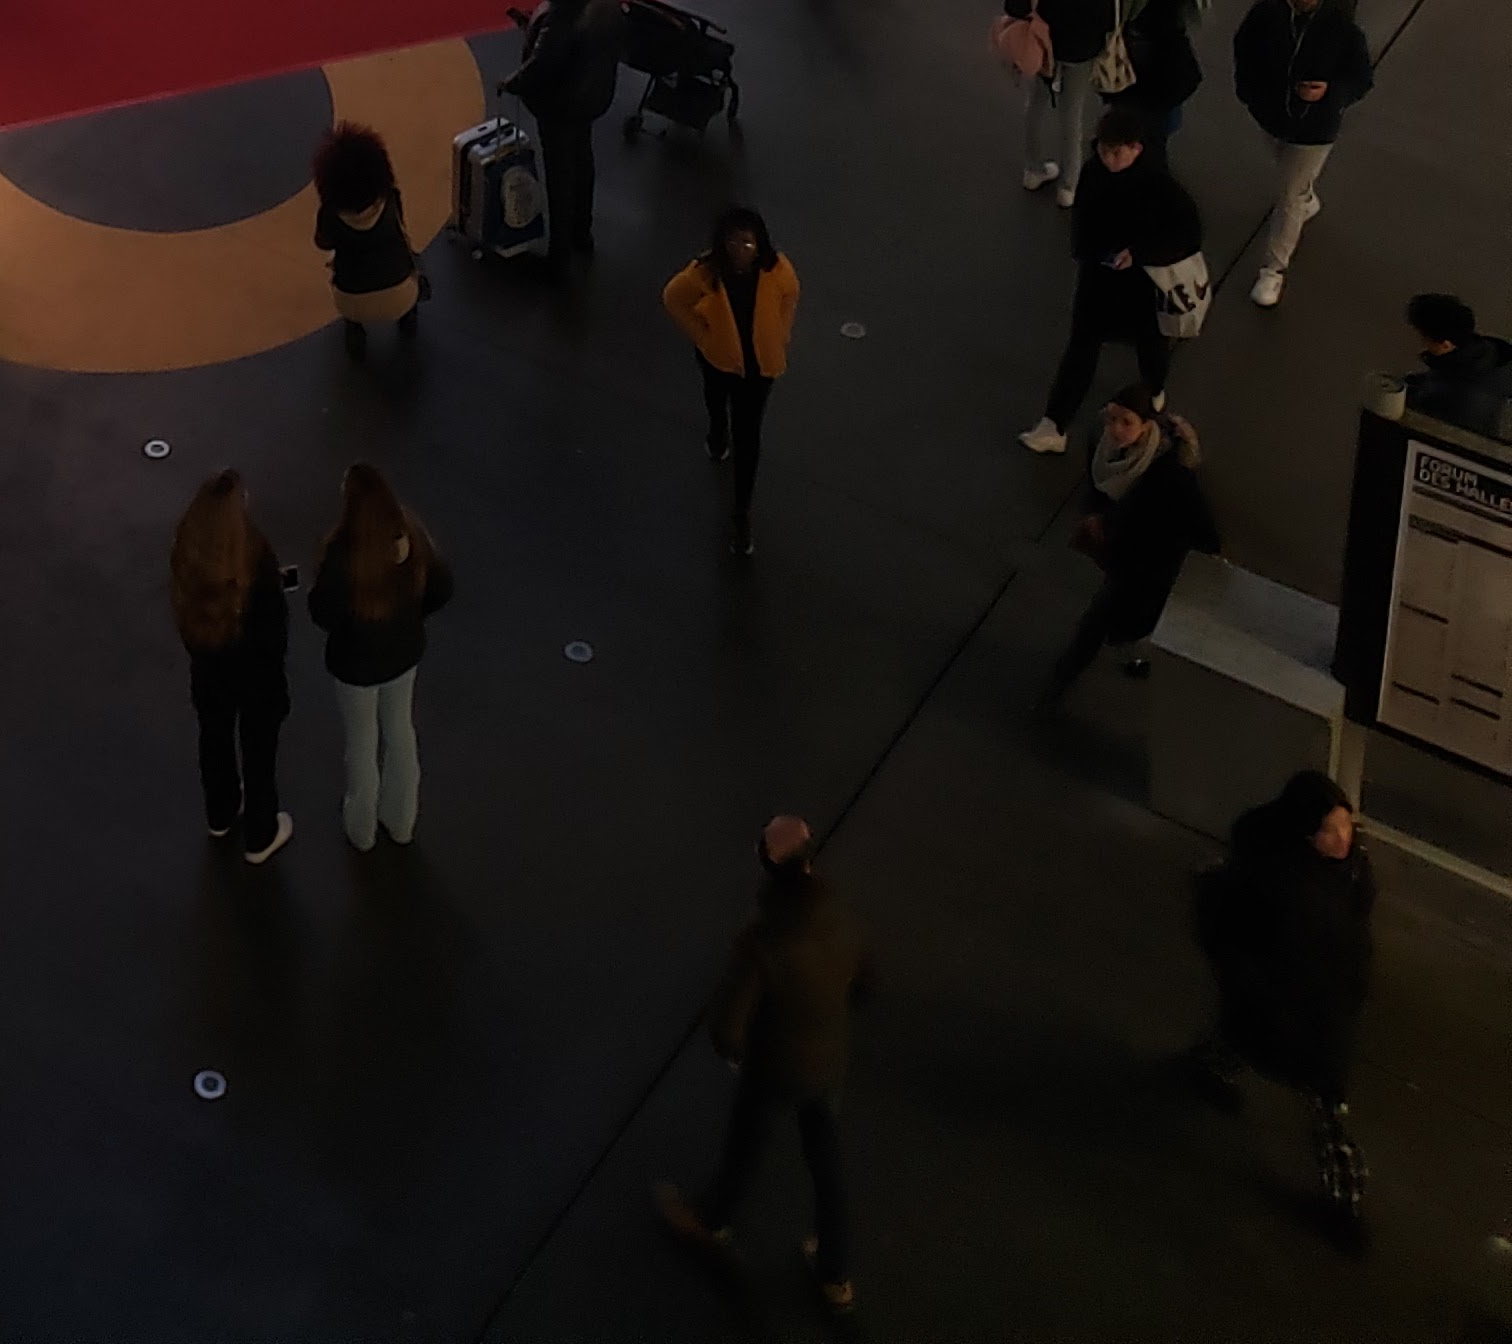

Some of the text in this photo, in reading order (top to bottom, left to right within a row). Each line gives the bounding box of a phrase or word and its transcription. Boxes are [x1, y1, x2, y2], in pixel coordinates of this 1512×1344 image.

[1419, 468, 1512, 511] DES HALLE
[1420, 455, 1478, 487] FORUM
